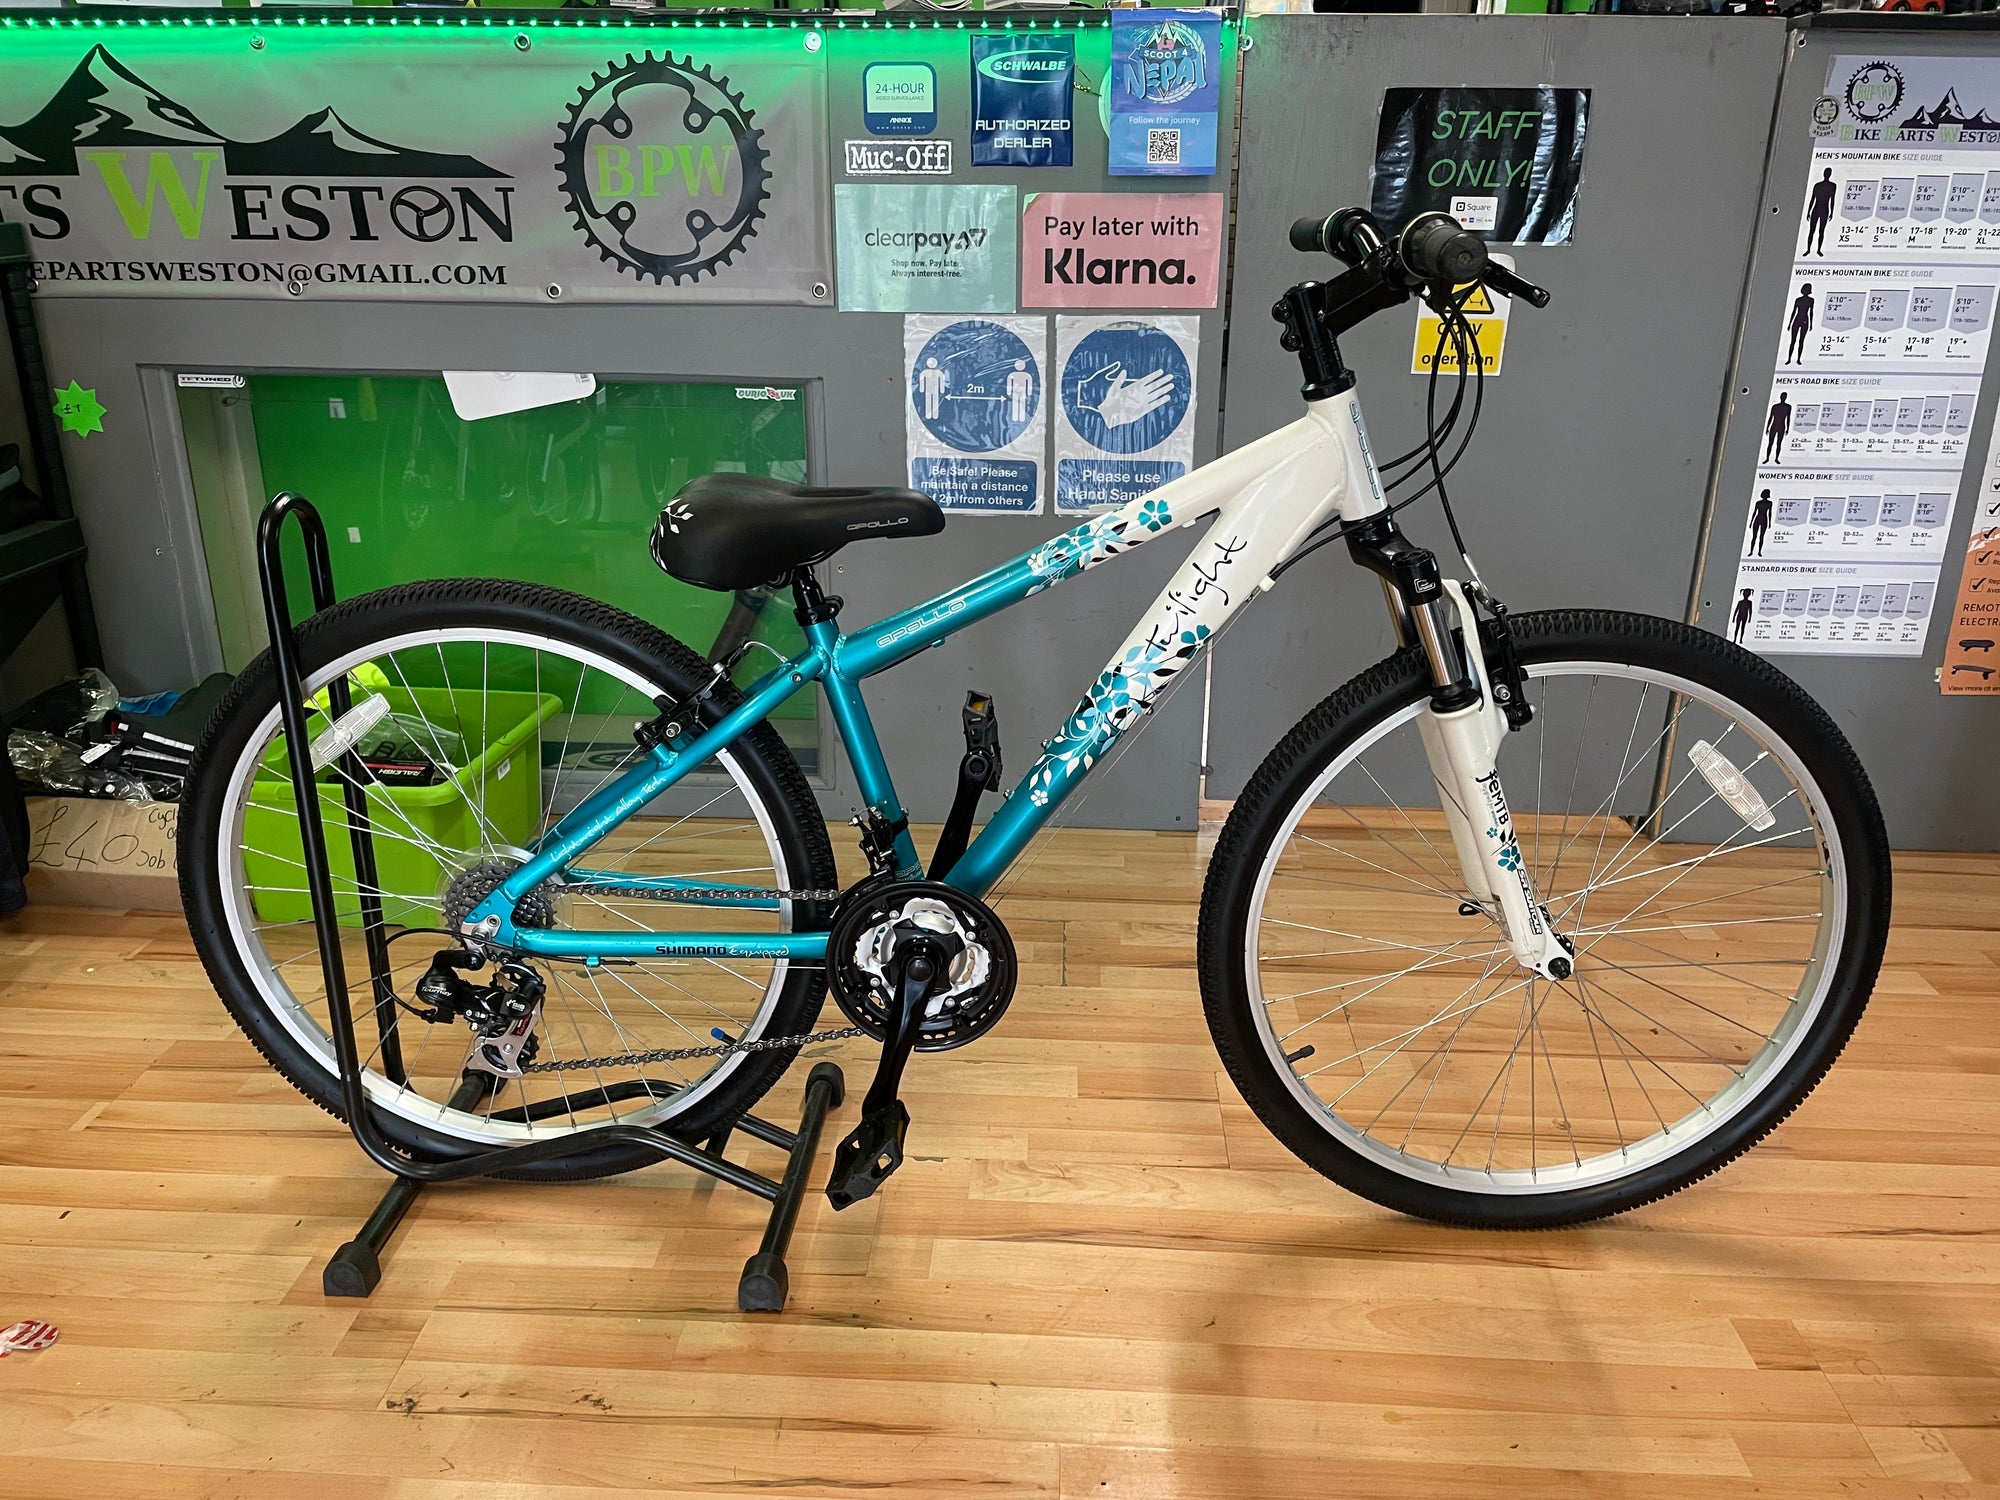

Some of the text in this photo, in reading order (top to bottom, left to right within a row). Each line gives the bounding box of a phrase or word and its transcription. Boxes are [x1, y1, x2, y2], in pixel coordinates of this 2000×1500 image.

[1143, 50, 1178, 59] SCOOT
[994, 60, 1067, 71] SCHWALBE
[875, 83, 925, 94] 24-HOUR
[1855, 84, 1895, 100] BPW
[975, 119, 1071, 131] AUTHORIZED
[1129, 116, 1201, 126] Follow the journey
[1432, 110, 1541, 140] STAFF
[994, 137, 1052, 148] DEALER
[851, 146, 948, 170] Muc-Off
[591, 144, 734, 198] BPW
[1427, 158, 1533, 188] ONLY!
[85, 152, 515, 243] WESTON
[1467, 203, 1491, 212] Square
[1045, 216, 1199, 240] Pay later with
[865, 228, 955, 254] clearpay
[1839, 234, 1850, 242] XS
[1976, 236, 1986, 244] XL
[891, 259, 909, 269] Shop
[929, 259, 942, 269] Pay
[1045, 248, 1196, 285] Klarna.
[1832, 269, 1872, 277] MOUNTAIN
[1911, 270, 1933, 278] GUIDE
[1948, 345, 1952, 353] L
[780, 390, 793, 398] UK
[967, 383, 985, 394] 2m
[932, 465, 1018, 478] Be Safe! Please
[1083, 470, 1161, 483] Please use
[921, 481, 968, 490] maintain
[981, 482, 1029, 492] distance
[1068, 488, 1105, 500] Hand
[940, 495, 956, 503] 2m
[960, 495, 984, 504] from
[988, 496, 1023, 506] others
[846, 516, 909, 531] APOLLO
[1145, 536, 1248, 655] twilight
[876, 598, 968, 649] APOLLO
[378, 768, 421, 777] RALEIGH
[27, 805, 140, 872] £40
[656, 944, 790, 959] SHIMANO Equipped
